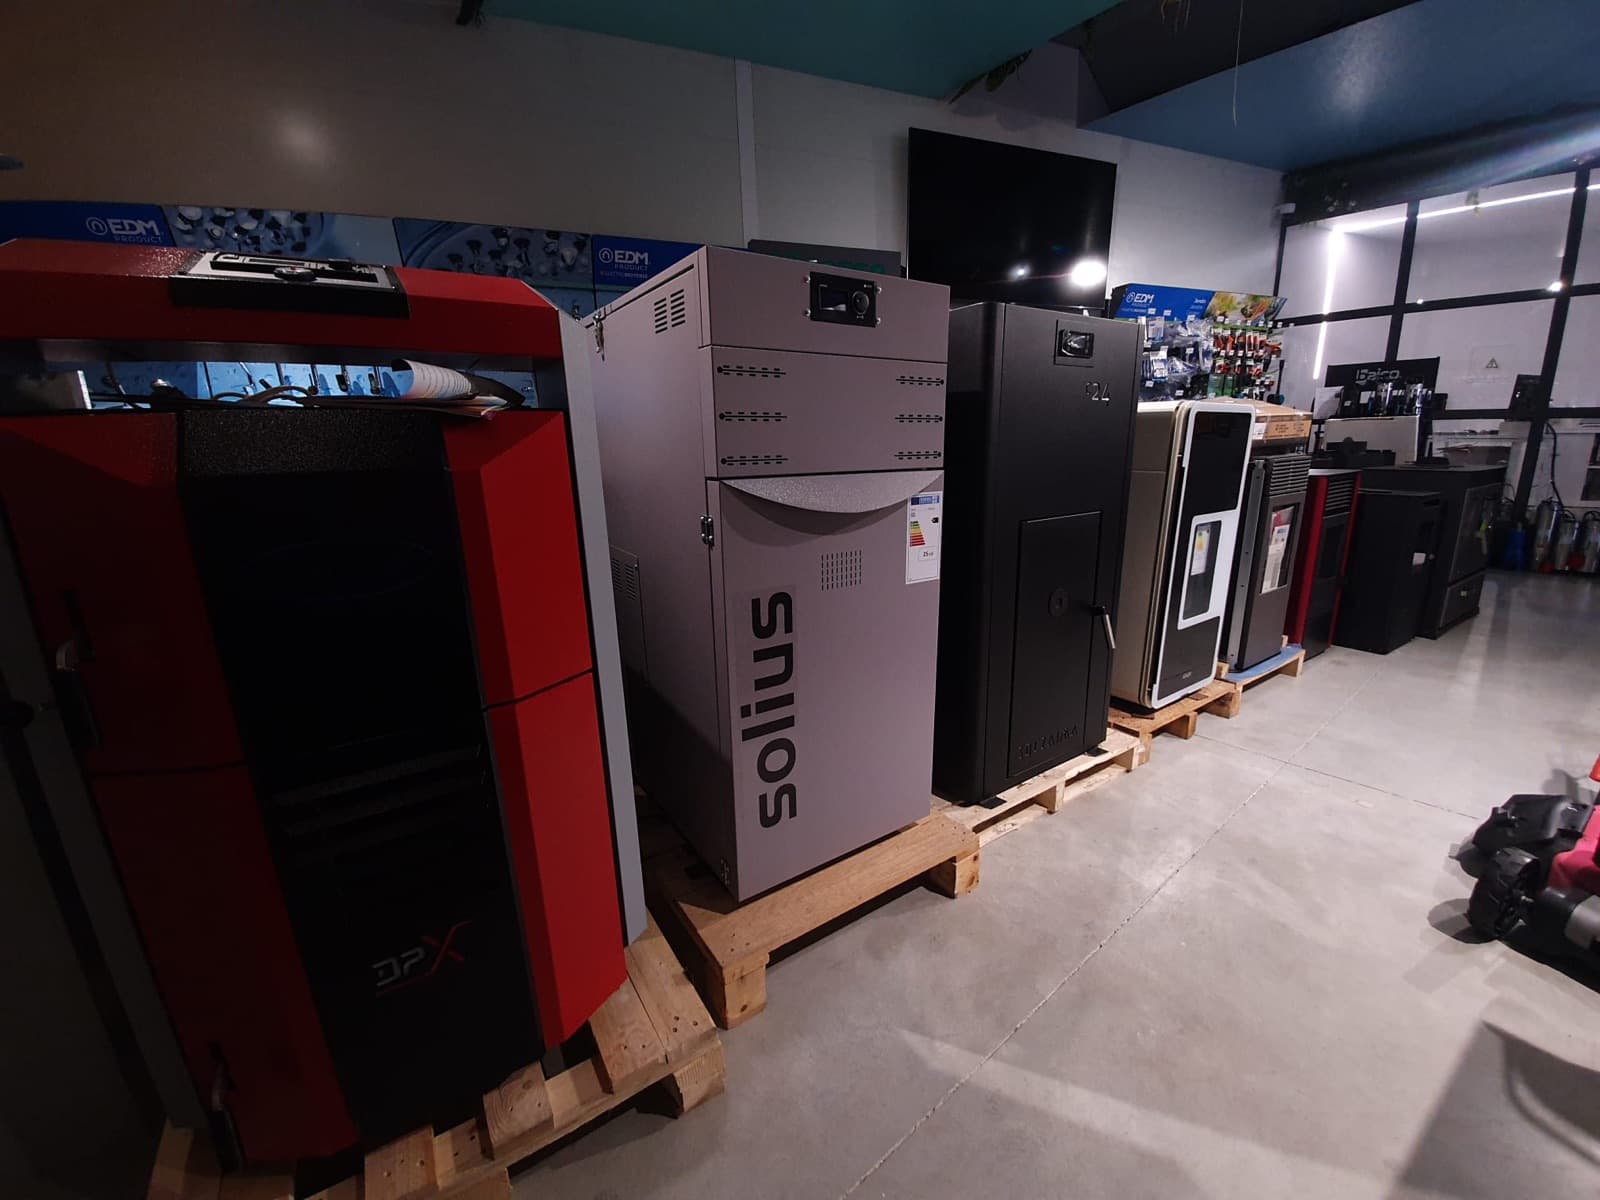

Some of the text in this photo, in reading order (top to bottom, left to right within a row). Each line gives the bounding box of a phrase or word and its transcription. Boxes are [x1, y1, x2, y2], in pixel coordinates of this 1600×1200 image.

[106, 218, 161, 236] EDM
[614, 249, 649, 265] EDM
[1134, 293, 1155, 305] EDM
[741, 591, 798, 829] solius
